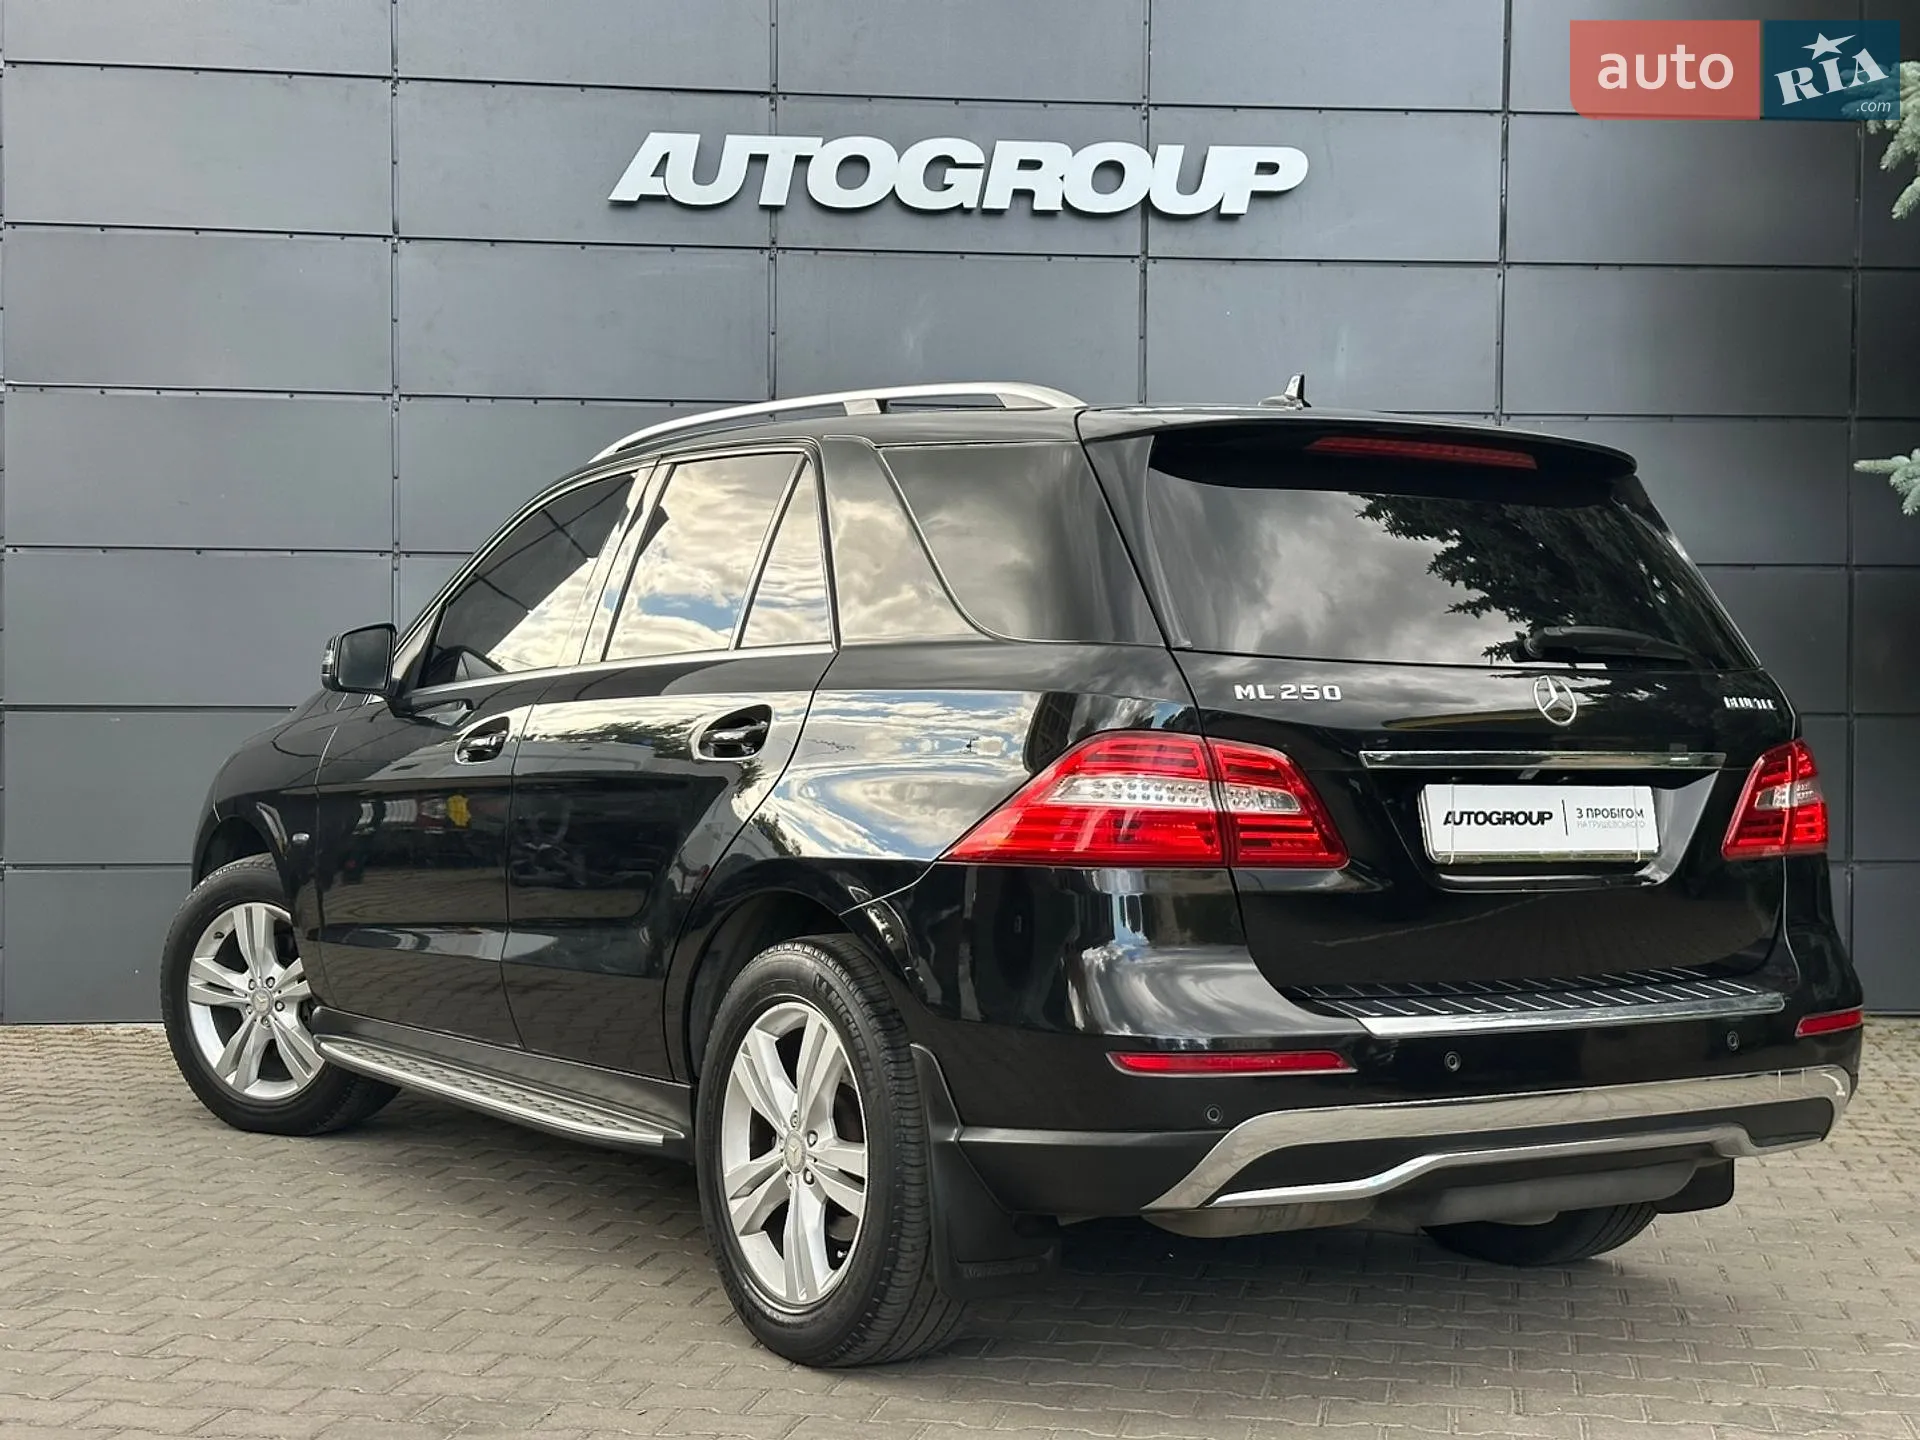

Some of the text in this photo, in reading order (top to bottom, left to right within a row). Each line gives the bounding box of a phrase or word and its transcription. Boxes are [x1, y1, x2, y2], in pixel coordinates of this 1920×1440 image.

[607, 131, 1310, 216] AUTOGROUP
[1233, 684, 1342, 701] ML 250
[1443, 810, 1553, 826] AUTOGROUP
[1585, 807, 1645, 819] ПРОБІГОМ
